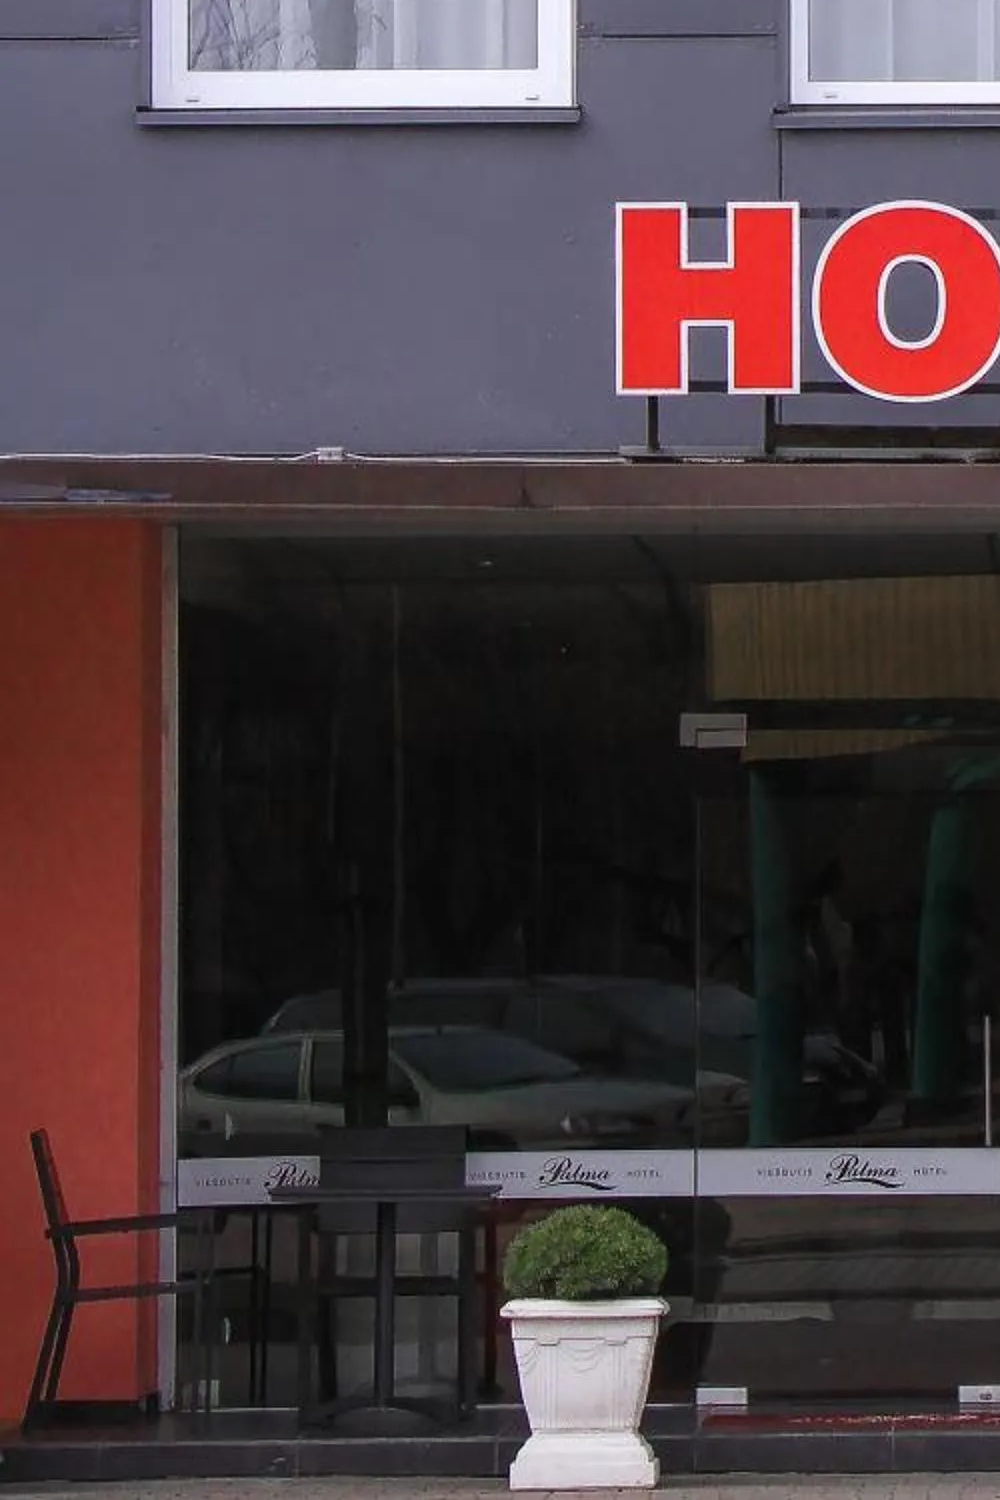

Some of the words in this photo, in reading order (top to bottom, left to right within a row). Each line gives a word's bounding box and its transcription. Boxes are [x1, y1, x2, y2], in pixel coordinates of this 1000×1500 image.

[264, 1161, 319, 1187] Palm
[537, 1156, 615, 1189] Palma
[626, 1170, 662, 1179] HOTEL
[826, 1153, 903, 1188] Palma
[913, 1167, 948, 1177] HOTEL
